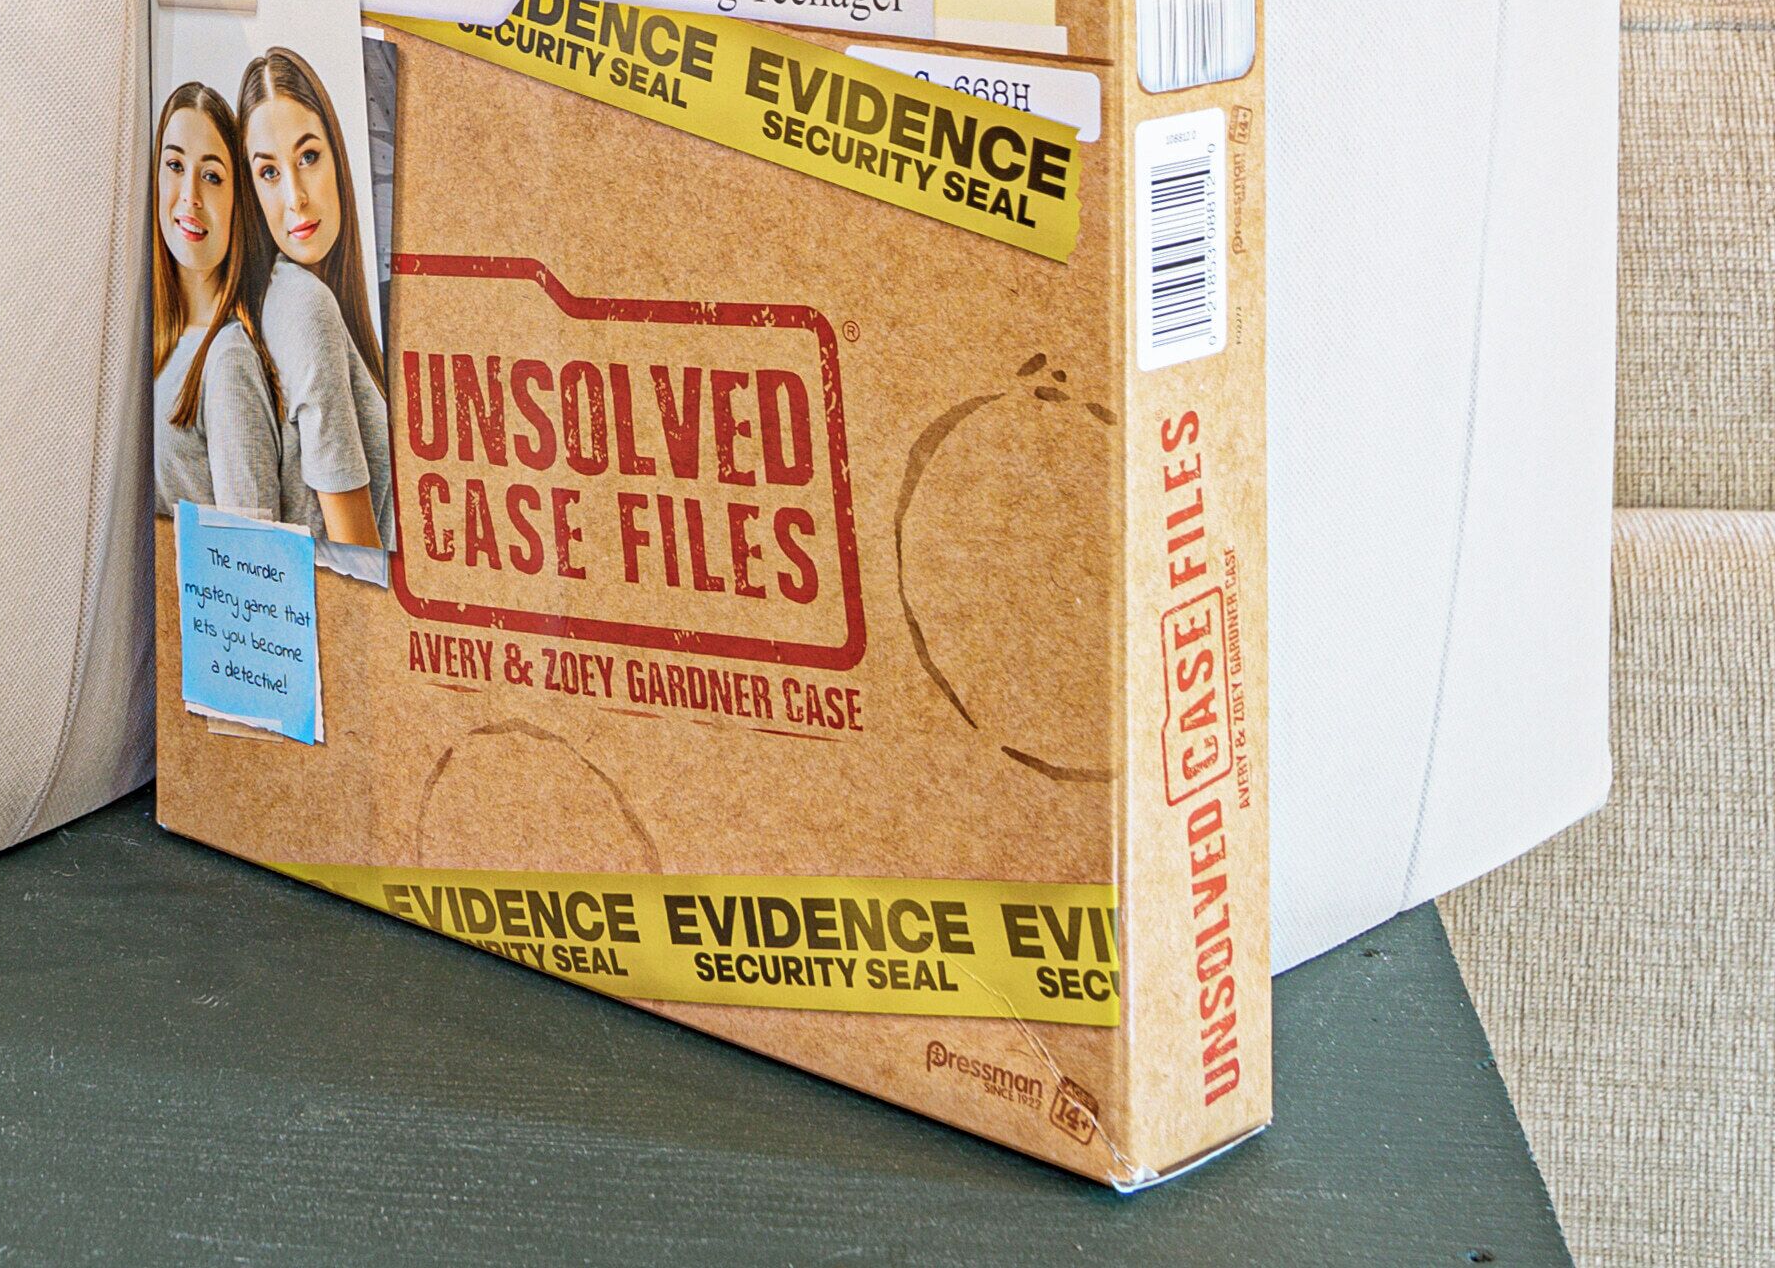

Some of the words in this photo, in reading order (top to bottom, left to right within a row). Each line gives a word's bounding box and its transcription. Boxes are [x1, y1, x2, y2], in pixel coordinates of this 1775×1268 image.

[609, 58, 688, 109] SEAL
[745, 48, 1072, 200] EVIDENCE
[761, 110, 937, 192] SECURITY
[942, 171, 1036, 229] SEAL
[403, 351, 814, 487] UNSOLVED
[1161, 410, 1209, 591] FILES
[207, 547, 232, 569] The
[237, 558, 286, 583] murder
[417, 473, 587, 580] CASE
[619, 492, 819, 605] FILES
[1223, 545, 1236, 591] CASE
[185, 582, 240, 618] mystery
[244, 599, 278, 622] game
[285, 605, 311, 628] that
[193, 617, 218, 637] lets
[222, 628, 246, 652] you
[251, 632, 304, 663] become
[1226, 598, 1242, 676] GARDNER
[211, 659, 221, 674] a
[225, 660, 287, 695] detective!
[409, 631, 493, 682] AVERY
[504, 643, 534, 687] &
[543, 649, 615, 698] ZOEY
[628, 661, 774, 725] GARDNER
[783, 679, 864, 732] CASE
[1173, 608, 1219, 781] CASE
[1231, 682, 1246, 726] ZOEY
[1234, 727, 1247, 748] &
[1238, 754, 1251, 810] AVERY
[382, 884, 641, 943] EVIDENCE
[664, 895, 975, 955] EVIDENCE
[1000, 904, 1119, 964] EVI
[554, 944, 629, 977] SEAL
[695, 952, 856, 989] SECURITY
[867, 959, 959, 992] SEAL
[1186, 798, 1241, 1108] UNSOLVED
[926, 1040, 1043, 1099] Pressman
[984, 1082, 1014, 1103] SINCE
[1055, 1100, 1091, 1132] 14+
